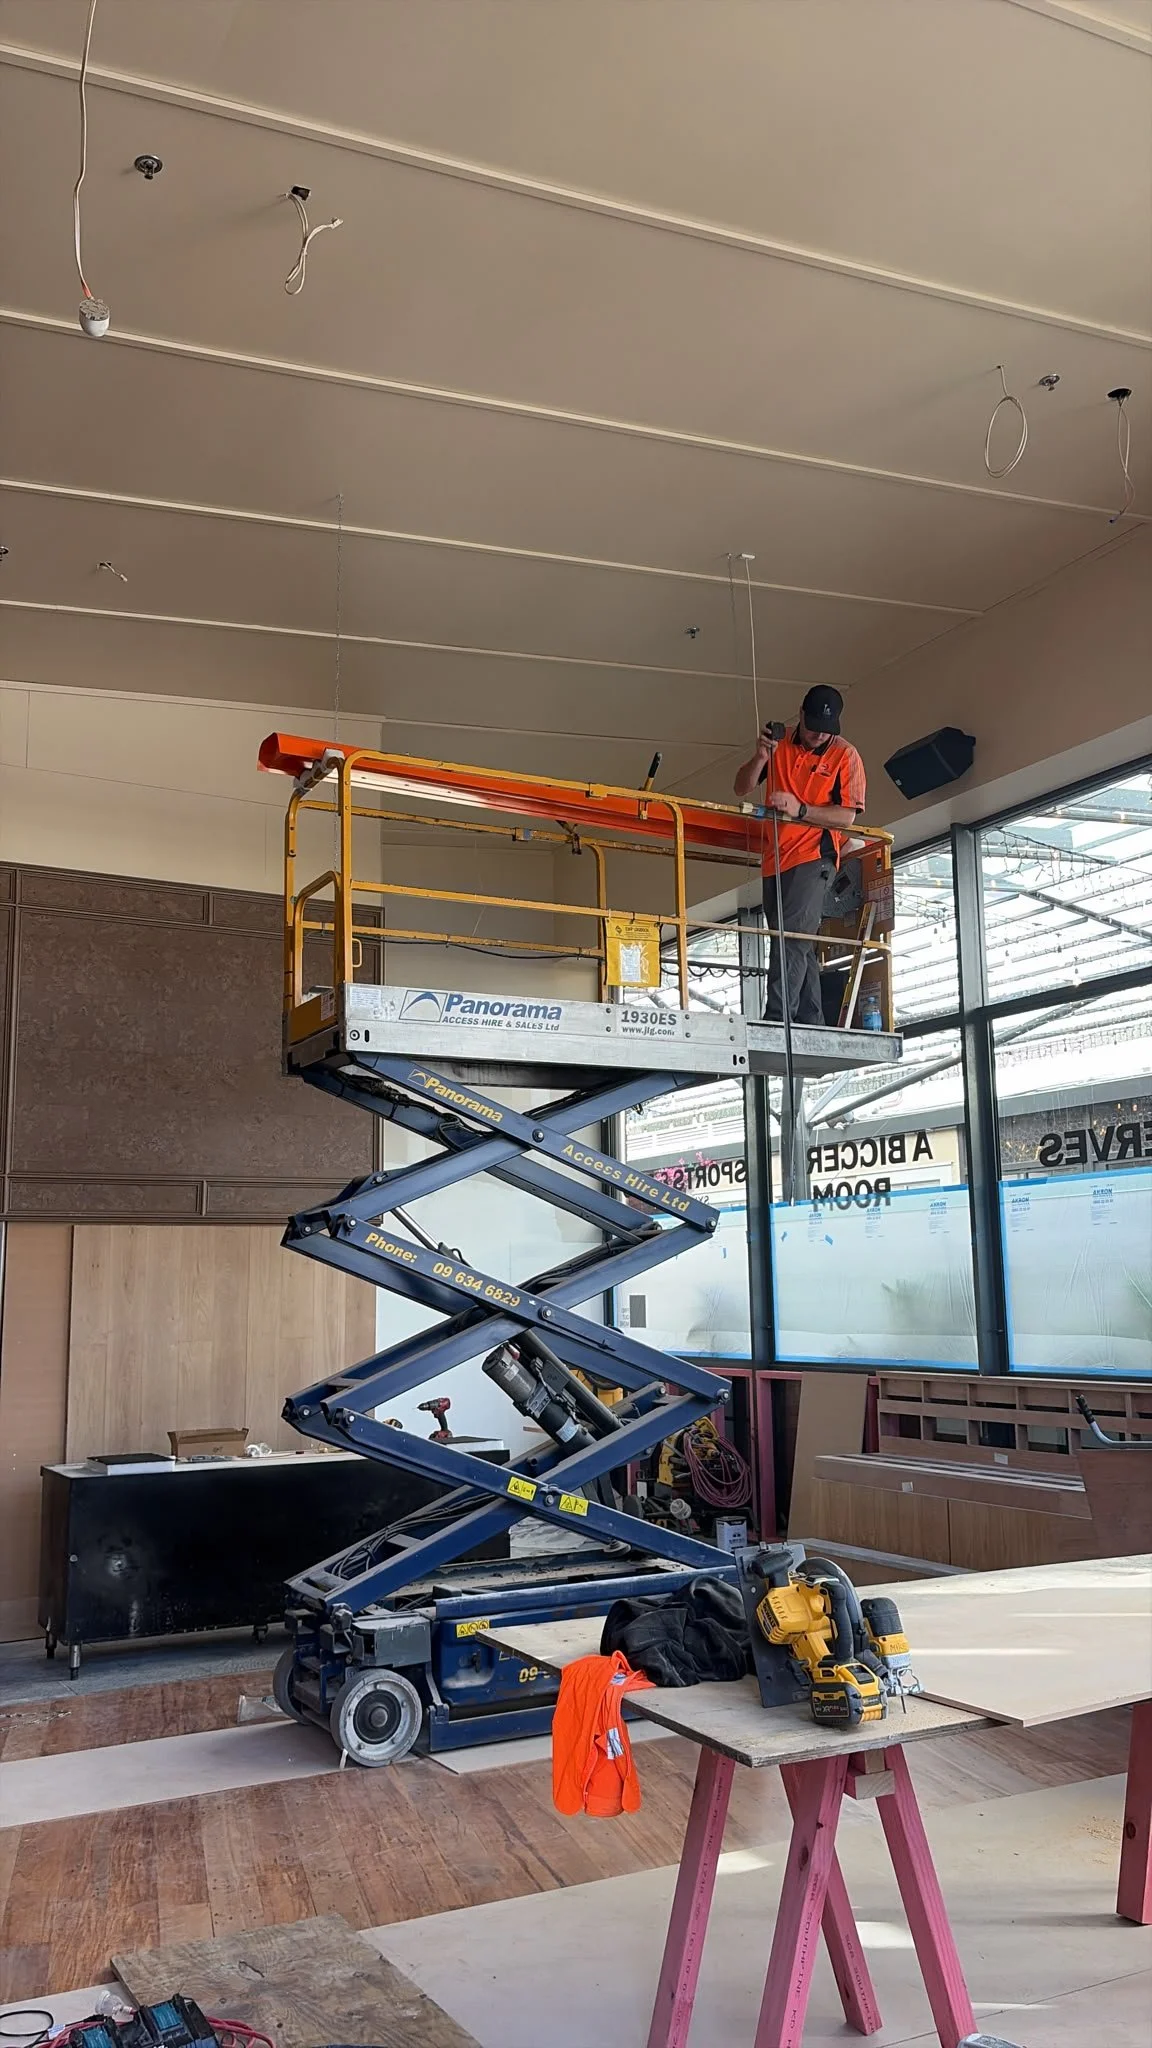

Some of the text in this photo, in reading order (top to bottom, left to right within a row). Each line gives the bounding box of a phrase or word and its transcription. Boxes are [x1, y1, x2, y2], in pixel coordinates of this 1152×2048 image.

[441, 1016, 560, 1031] ACCESS HIRE & SALES Ltd
[444, 993, 562, 1020] Panorama
[621, 1010, 677, 1025] 1930ES
[424, 1076, 504, 1123] Panorama
[561, 1143, 622, 1182] Access
[623, 1172, 659, 1199] Hire
[661, 1191, 691, 1212] Ltd
[365, 1232, 521, 1307] Phone: 09 634 6829
